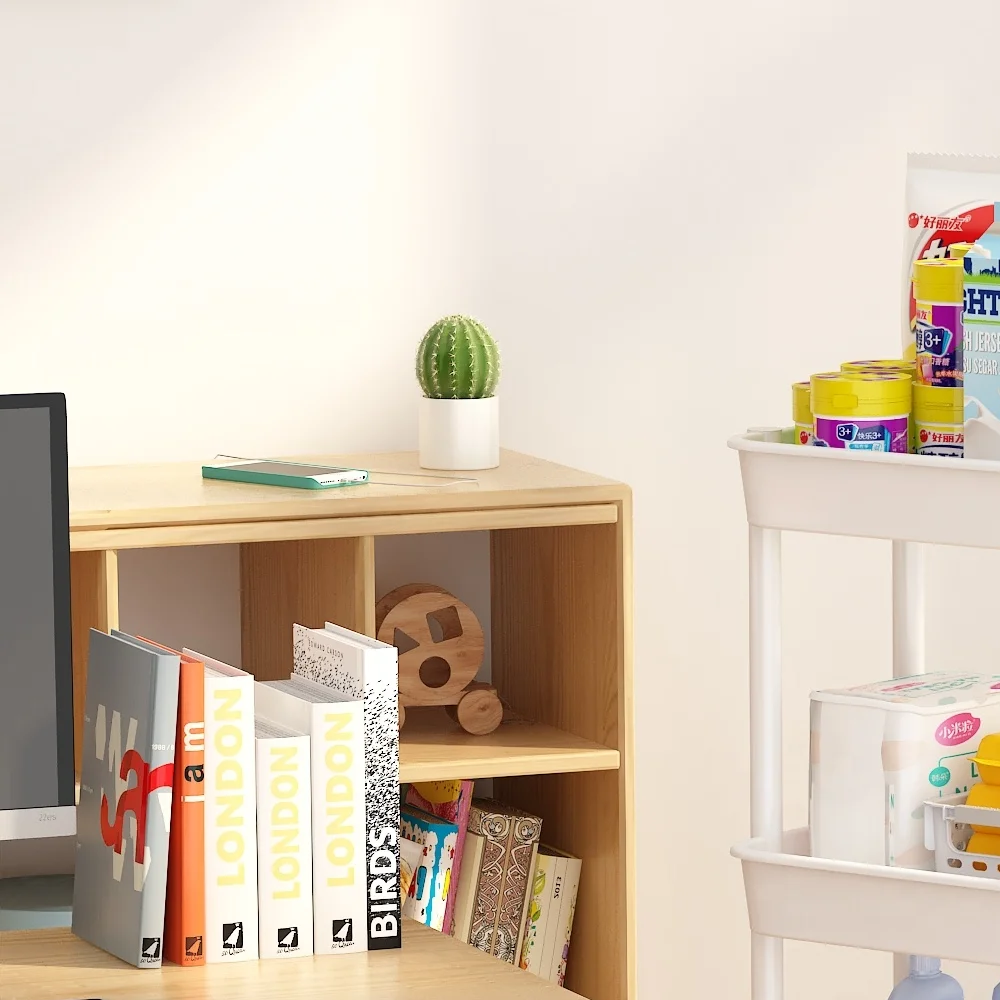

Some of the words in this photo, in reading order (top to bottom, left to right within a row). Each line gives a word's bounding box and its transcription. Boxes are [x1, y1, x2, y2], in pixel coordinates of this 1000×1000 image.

[973, 359, 997, 376] SEGAR
[213, 688, 245, 887] LONDON
[269, 746, 300, 899] LONDON
[323, 712, 355, 887] LONDON
[369, 827, 398, 939] BIRDS
